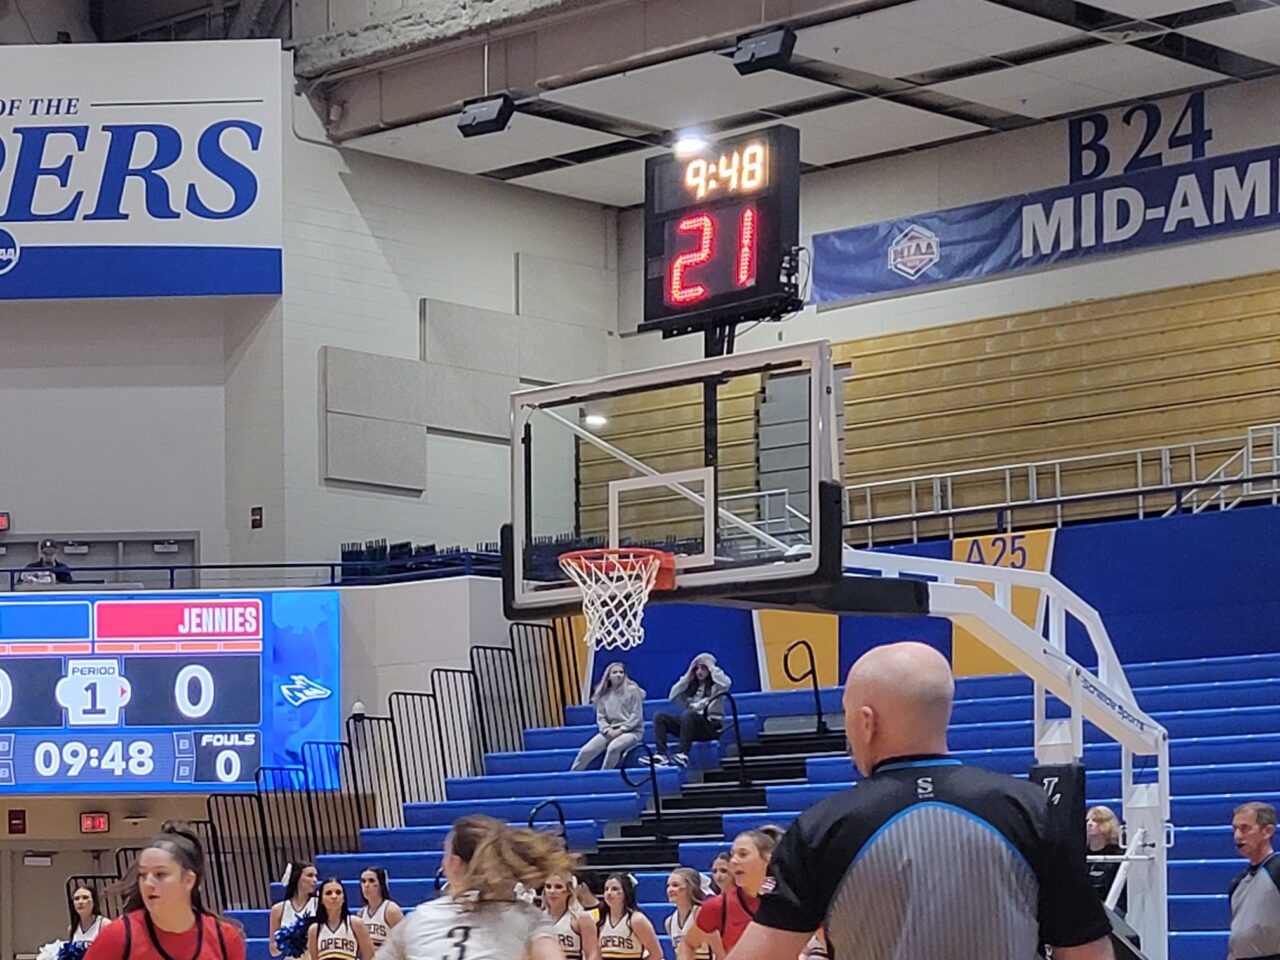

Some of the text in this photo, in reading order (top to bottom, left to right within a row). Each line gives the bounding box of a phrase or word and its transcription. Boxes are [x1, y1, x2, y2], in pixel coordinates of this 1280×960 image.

[28, 97, 81, 116] THE
[1068, 91, 1213, 186] B24
[685, 143, 763, 201] 9:48
[1021, 160, 1280, 259] MID-AM
[670, 207, 756, 303] 21
[966, 534, 1027, 569] A25
[178, 606, 258, 634] JENNIES
[71, 666, 116, 675] PERIOD
[81, 682, 107, 715] 1
[174, 664, 215, 718] 0
[201, 733, 257, 747] FOULS
[33, 740, 155, 776] 09:48
[215, 750, 241, 782] 0
[319, 938, 355, 952] OPERS
[600, 936, 634, 950] OPERS
